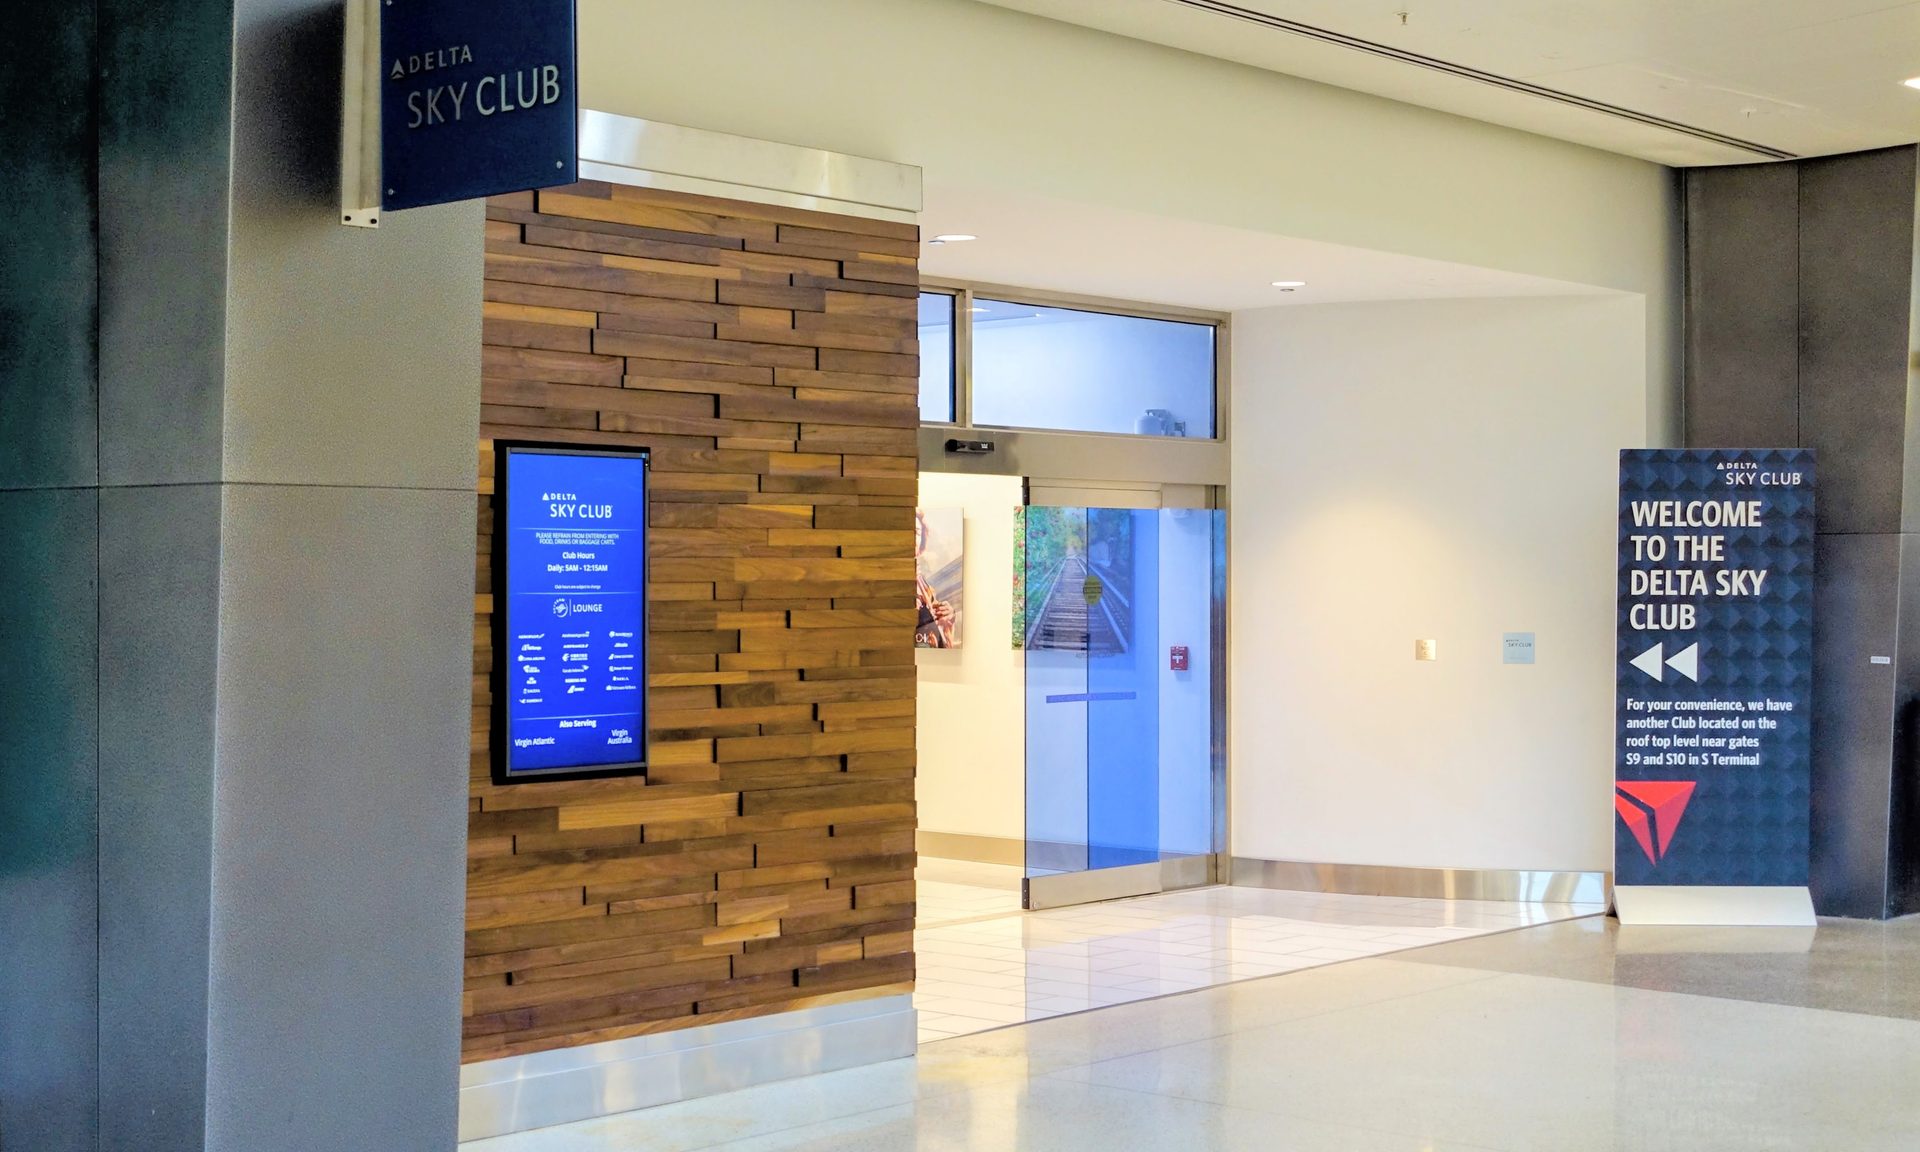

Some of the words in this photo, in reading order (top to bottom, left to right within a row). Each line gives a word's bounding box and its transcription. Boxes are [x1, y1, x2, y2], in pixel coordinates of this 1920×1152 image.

[409, 44, 473, 74] DELTA
[408, 81, 468, 128] SKY
[476, 64, 560, 116] CLUB
[1726, 472, 1756, 485] SKY
[1760, 472, 1801, 485] CLUB
[550, 504, 576, 518] SKY
[578, 504, 612, 518] CLUB
[1630, 500, 1762, 527] WELCOME
[1630, 535, 1666, 562] TO
[1674, 535, 1724, 561] THE
[547, 564, 564, 573] Daily:
[1630, 570, 1708, 596] DELTA
[1715, 570, 1767, 596] SKY
[573, 604, 603, 612] LOUNGE
[1630, 603, 1696, 630] CLUB
[1627, 698, 1644, 711] For
[1647, 701, 1672, 713] your
[1674, 699, 1745, 712] convenience,
[1748, 701, 1764, 711] we
[1766, 699, 1792, 711] have
[559, 720, 573, 728] Also
[574, 719, 597, 728] Serving
[1626, 716, 1669, 729] another
[1672, 716, 1696, 729] Club
[1698, 716, 1739, 729] located
[1742, 720, 1756, 729] on
[1758, 717, 1776, 729] the
[611, 728, 628, 737] Virgin
[515, 738, 532, 748] Virgin
[533, 737, 555, 746] Atlantic
[608, 736, 632, 745] Australia
[1626, 734, 1650, 747] roof
[1652, 736, 1671, 749] top
[1673, 734, 1699, 747] level
[1702, 737, 1726, 747] near
[1728, 736, 1759, 749] gates
[1626, 753, 1640, 765] S9
[1643, 753, 1663, 765] and
[1666, 753, 1686, 765] S10
[1688, 753, 1699, 765] in
[1701, 753, 1709, 765] S
[1711, 753, 1759, 765] Terminal
